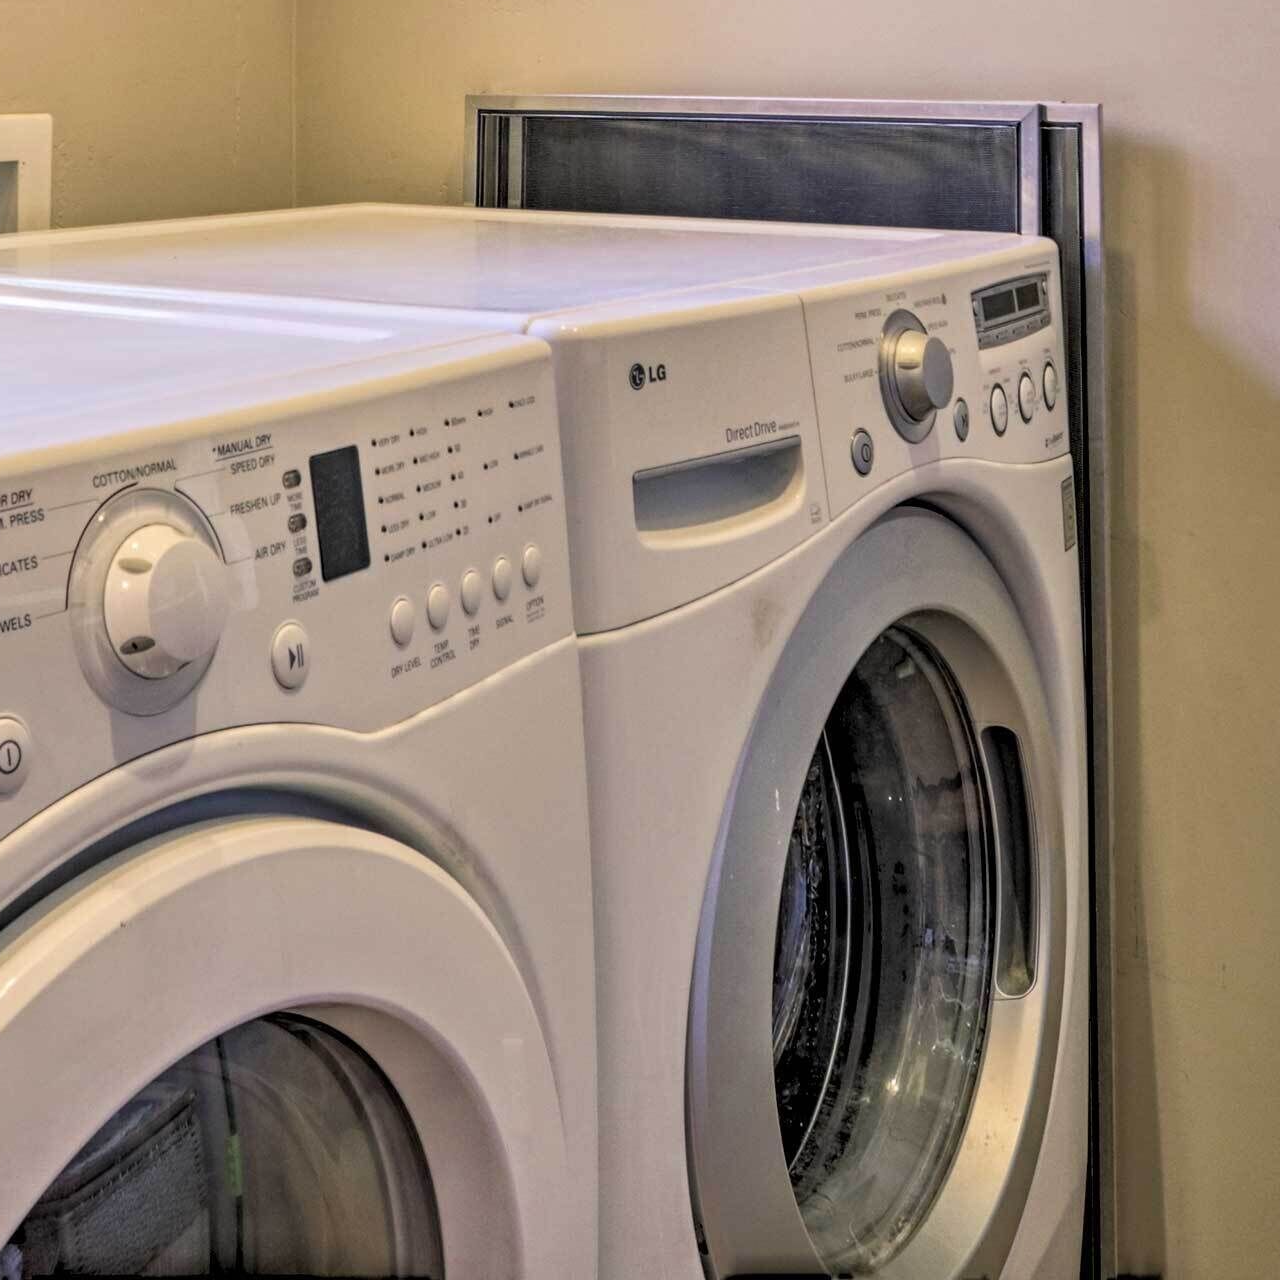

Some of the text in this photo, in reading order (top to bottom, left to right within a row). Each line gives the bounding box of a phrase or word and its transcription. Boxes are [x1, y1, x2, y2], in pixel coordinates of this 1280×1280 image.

[649, 363, 666, 383] LG
[725, 424, 753, 443] Direct
[754, 420, 777, 437] Drive
[217, 433, 272, 457] MANUAL DRY
[92, 458, 178, 489] COTTON/NORMAL
[230, 454, 276, 475] SPEED DRY
[10, 488, 33, 504] DRY
[230, 492, 282, 515] FRESHEN UP
[9, 508, 45, 527] PRESS
[254, 541, 287, 561] AIR DRY
[469, 638, 480, 651] DRY
[391, 656, 422, 679] DRY LEVEL
[430, 649, 457, 669] CONTROL
